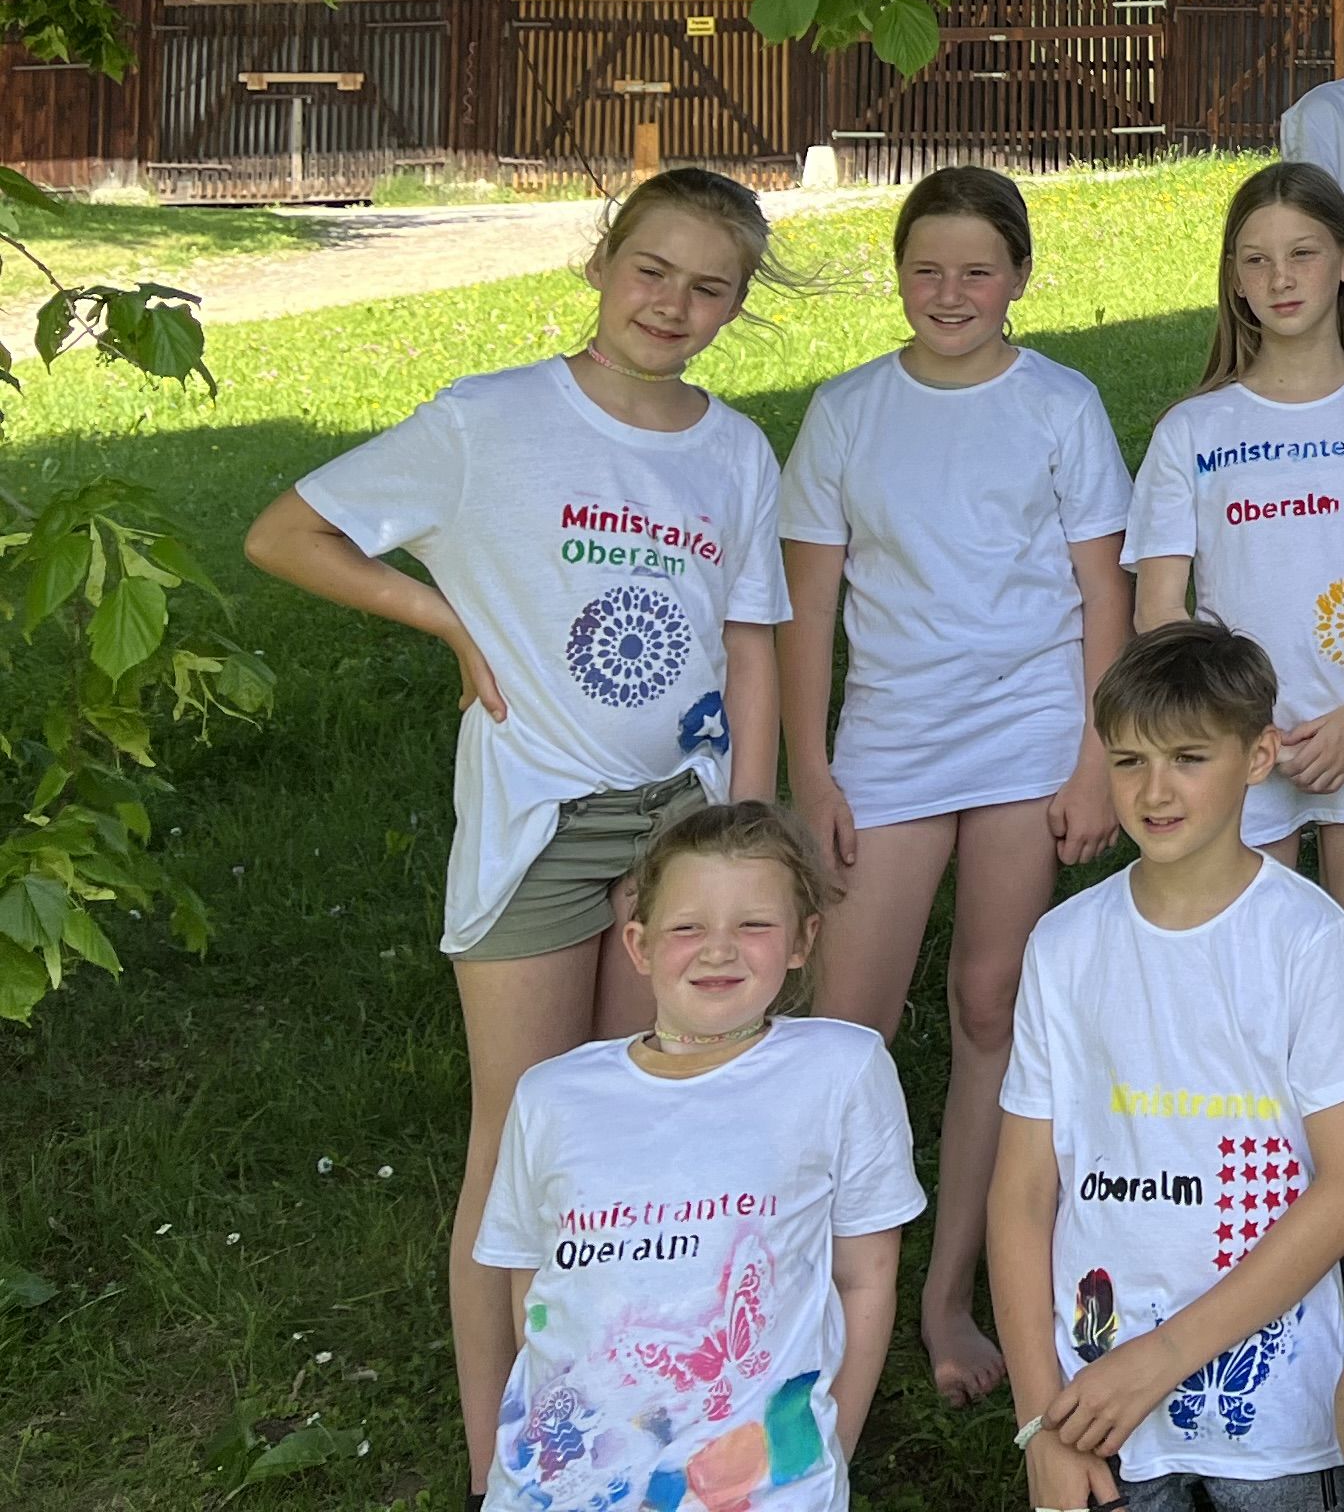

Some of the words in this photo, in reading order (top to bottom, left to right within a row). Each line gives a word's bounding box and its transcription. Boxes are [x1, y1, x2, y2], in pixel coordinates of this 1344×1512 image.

[1226, 492, 1340, 526] Oberalm
[1080, 1170, 1204, 1207] Oberalm
[557, 1192, 778, 1236] Ministranten
[555, 1232, 701, 1271] Oberalm
